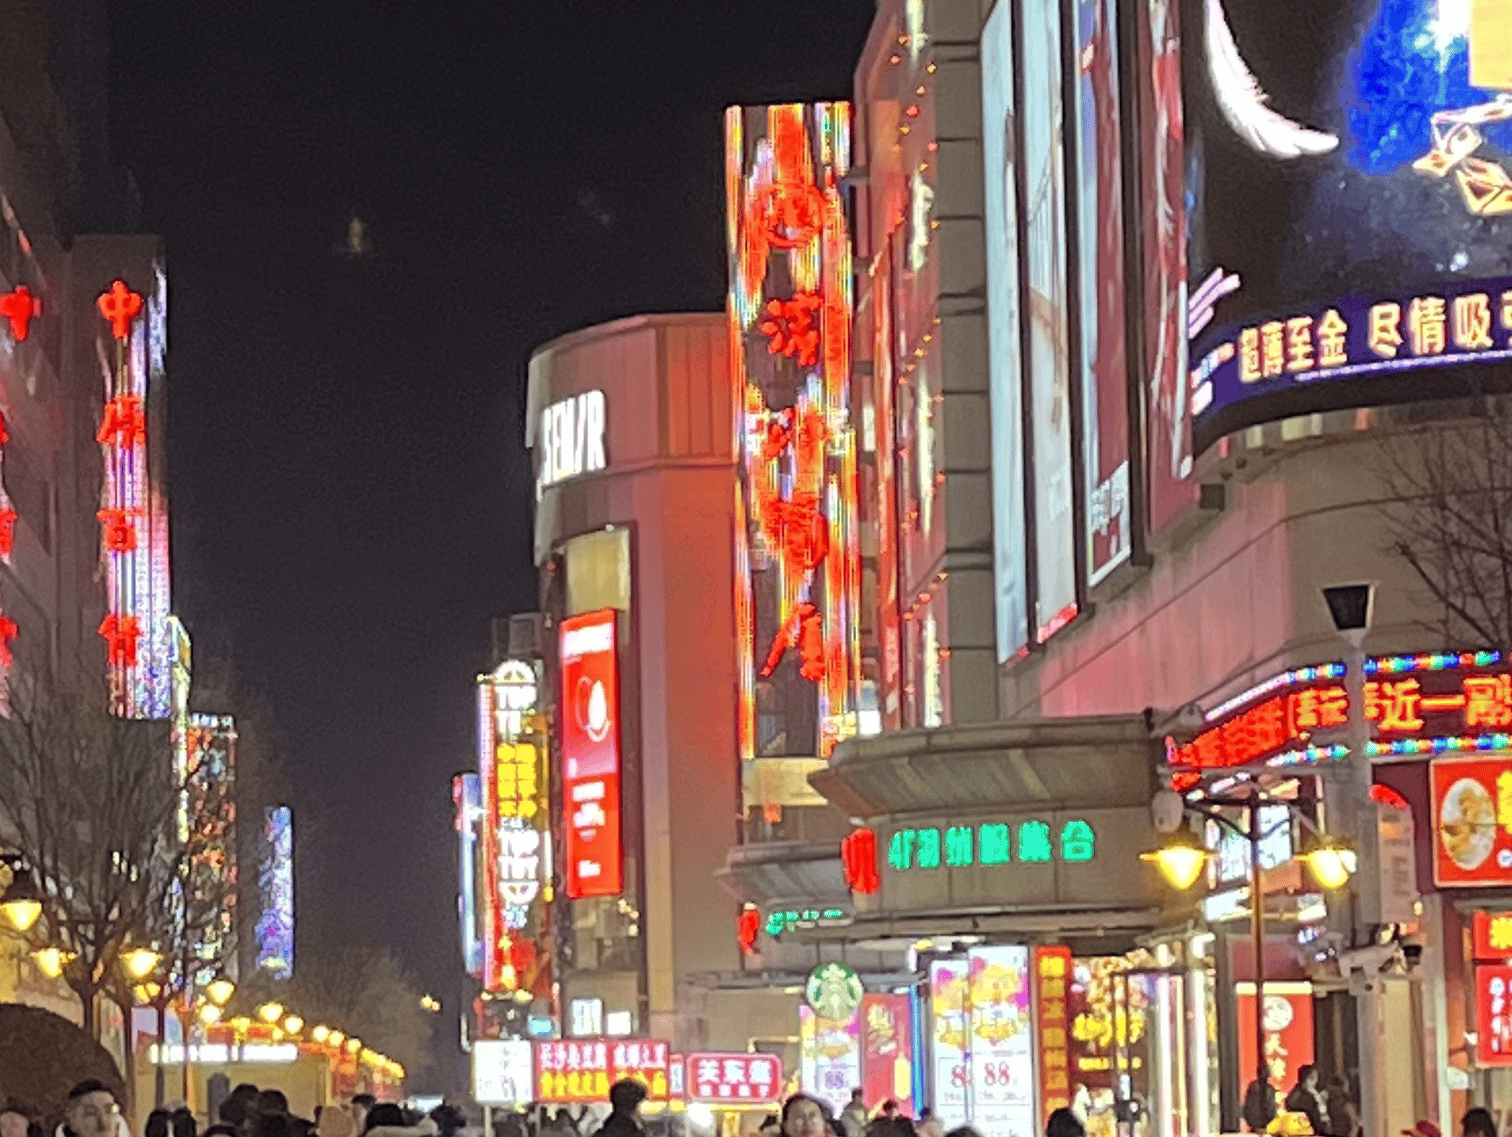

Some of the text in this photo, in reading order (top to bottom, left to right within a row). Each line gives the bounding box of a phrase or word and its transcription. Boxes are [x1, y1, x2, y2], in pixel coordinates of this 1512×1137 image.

[1367, 290, 1512, 356] 尽情吸
[983, 1060, 1011, 1086] 88
